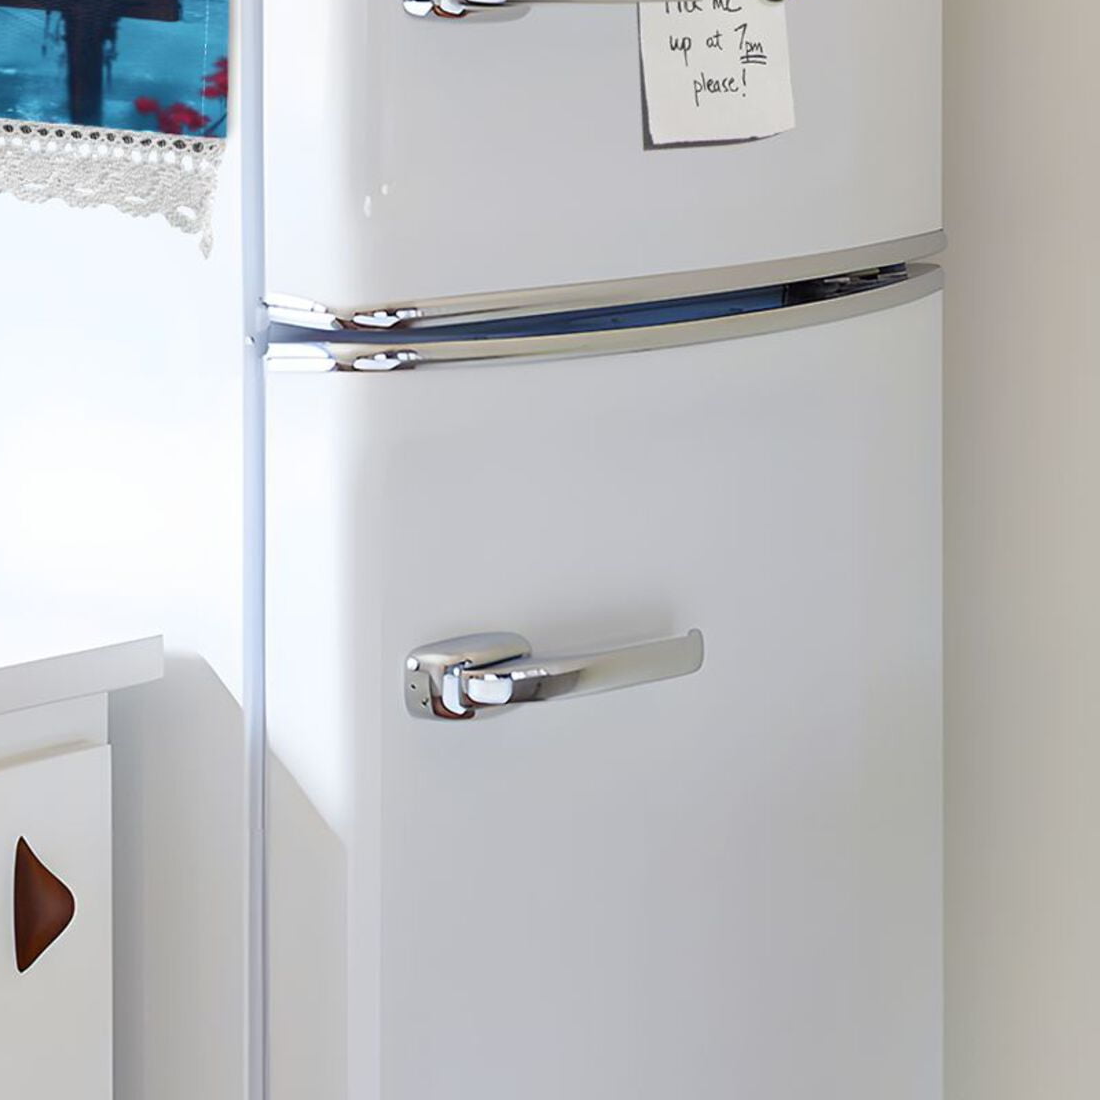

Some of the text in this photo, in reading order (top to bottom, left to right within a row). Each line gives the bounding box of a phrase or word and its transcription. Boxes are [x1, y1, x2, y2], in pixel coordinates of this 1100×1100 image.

[669, 35, 692, 66] up
[706, 30, 723, 51] at
[693, 68, 747, 107] please!
